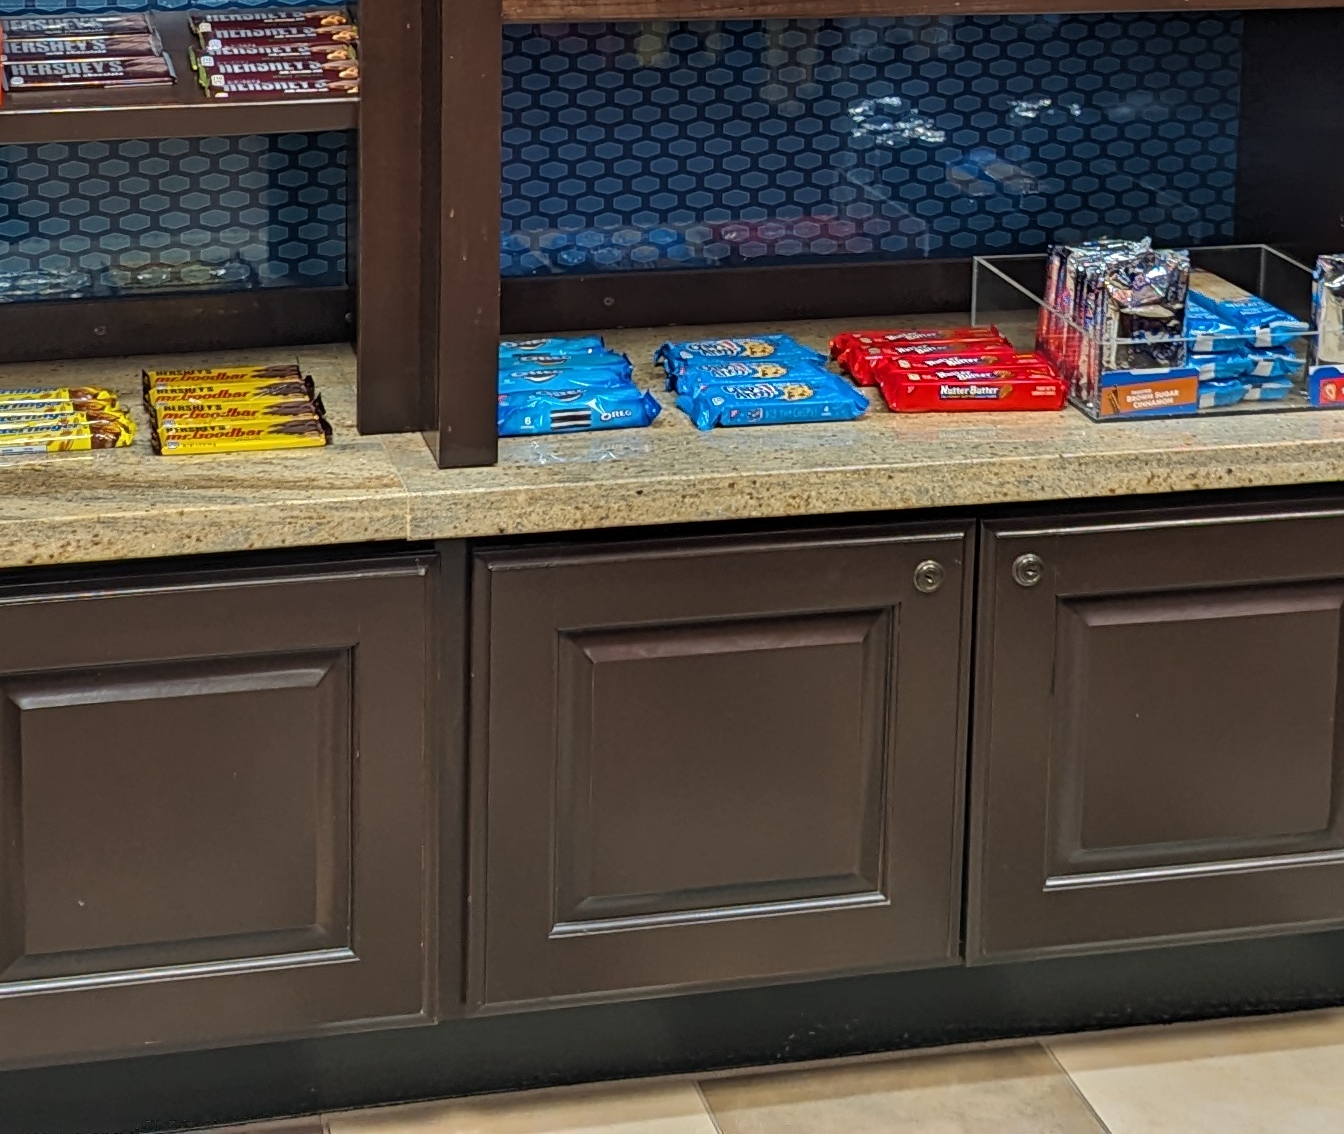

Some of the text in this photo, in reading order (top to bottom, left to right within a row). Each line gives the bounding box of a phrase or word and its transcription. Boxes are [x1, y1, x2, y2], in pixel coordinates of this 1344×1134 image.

[10, 60, 124, 76] HERSHEY'S
[940, 385, 999, 395] Nutter Butter
[1126, 389, 1180, 404] BROWN SUGAR
[1132, 397, 1174, 409] CINNAMON
[600, 409, 633, 422] OREO
